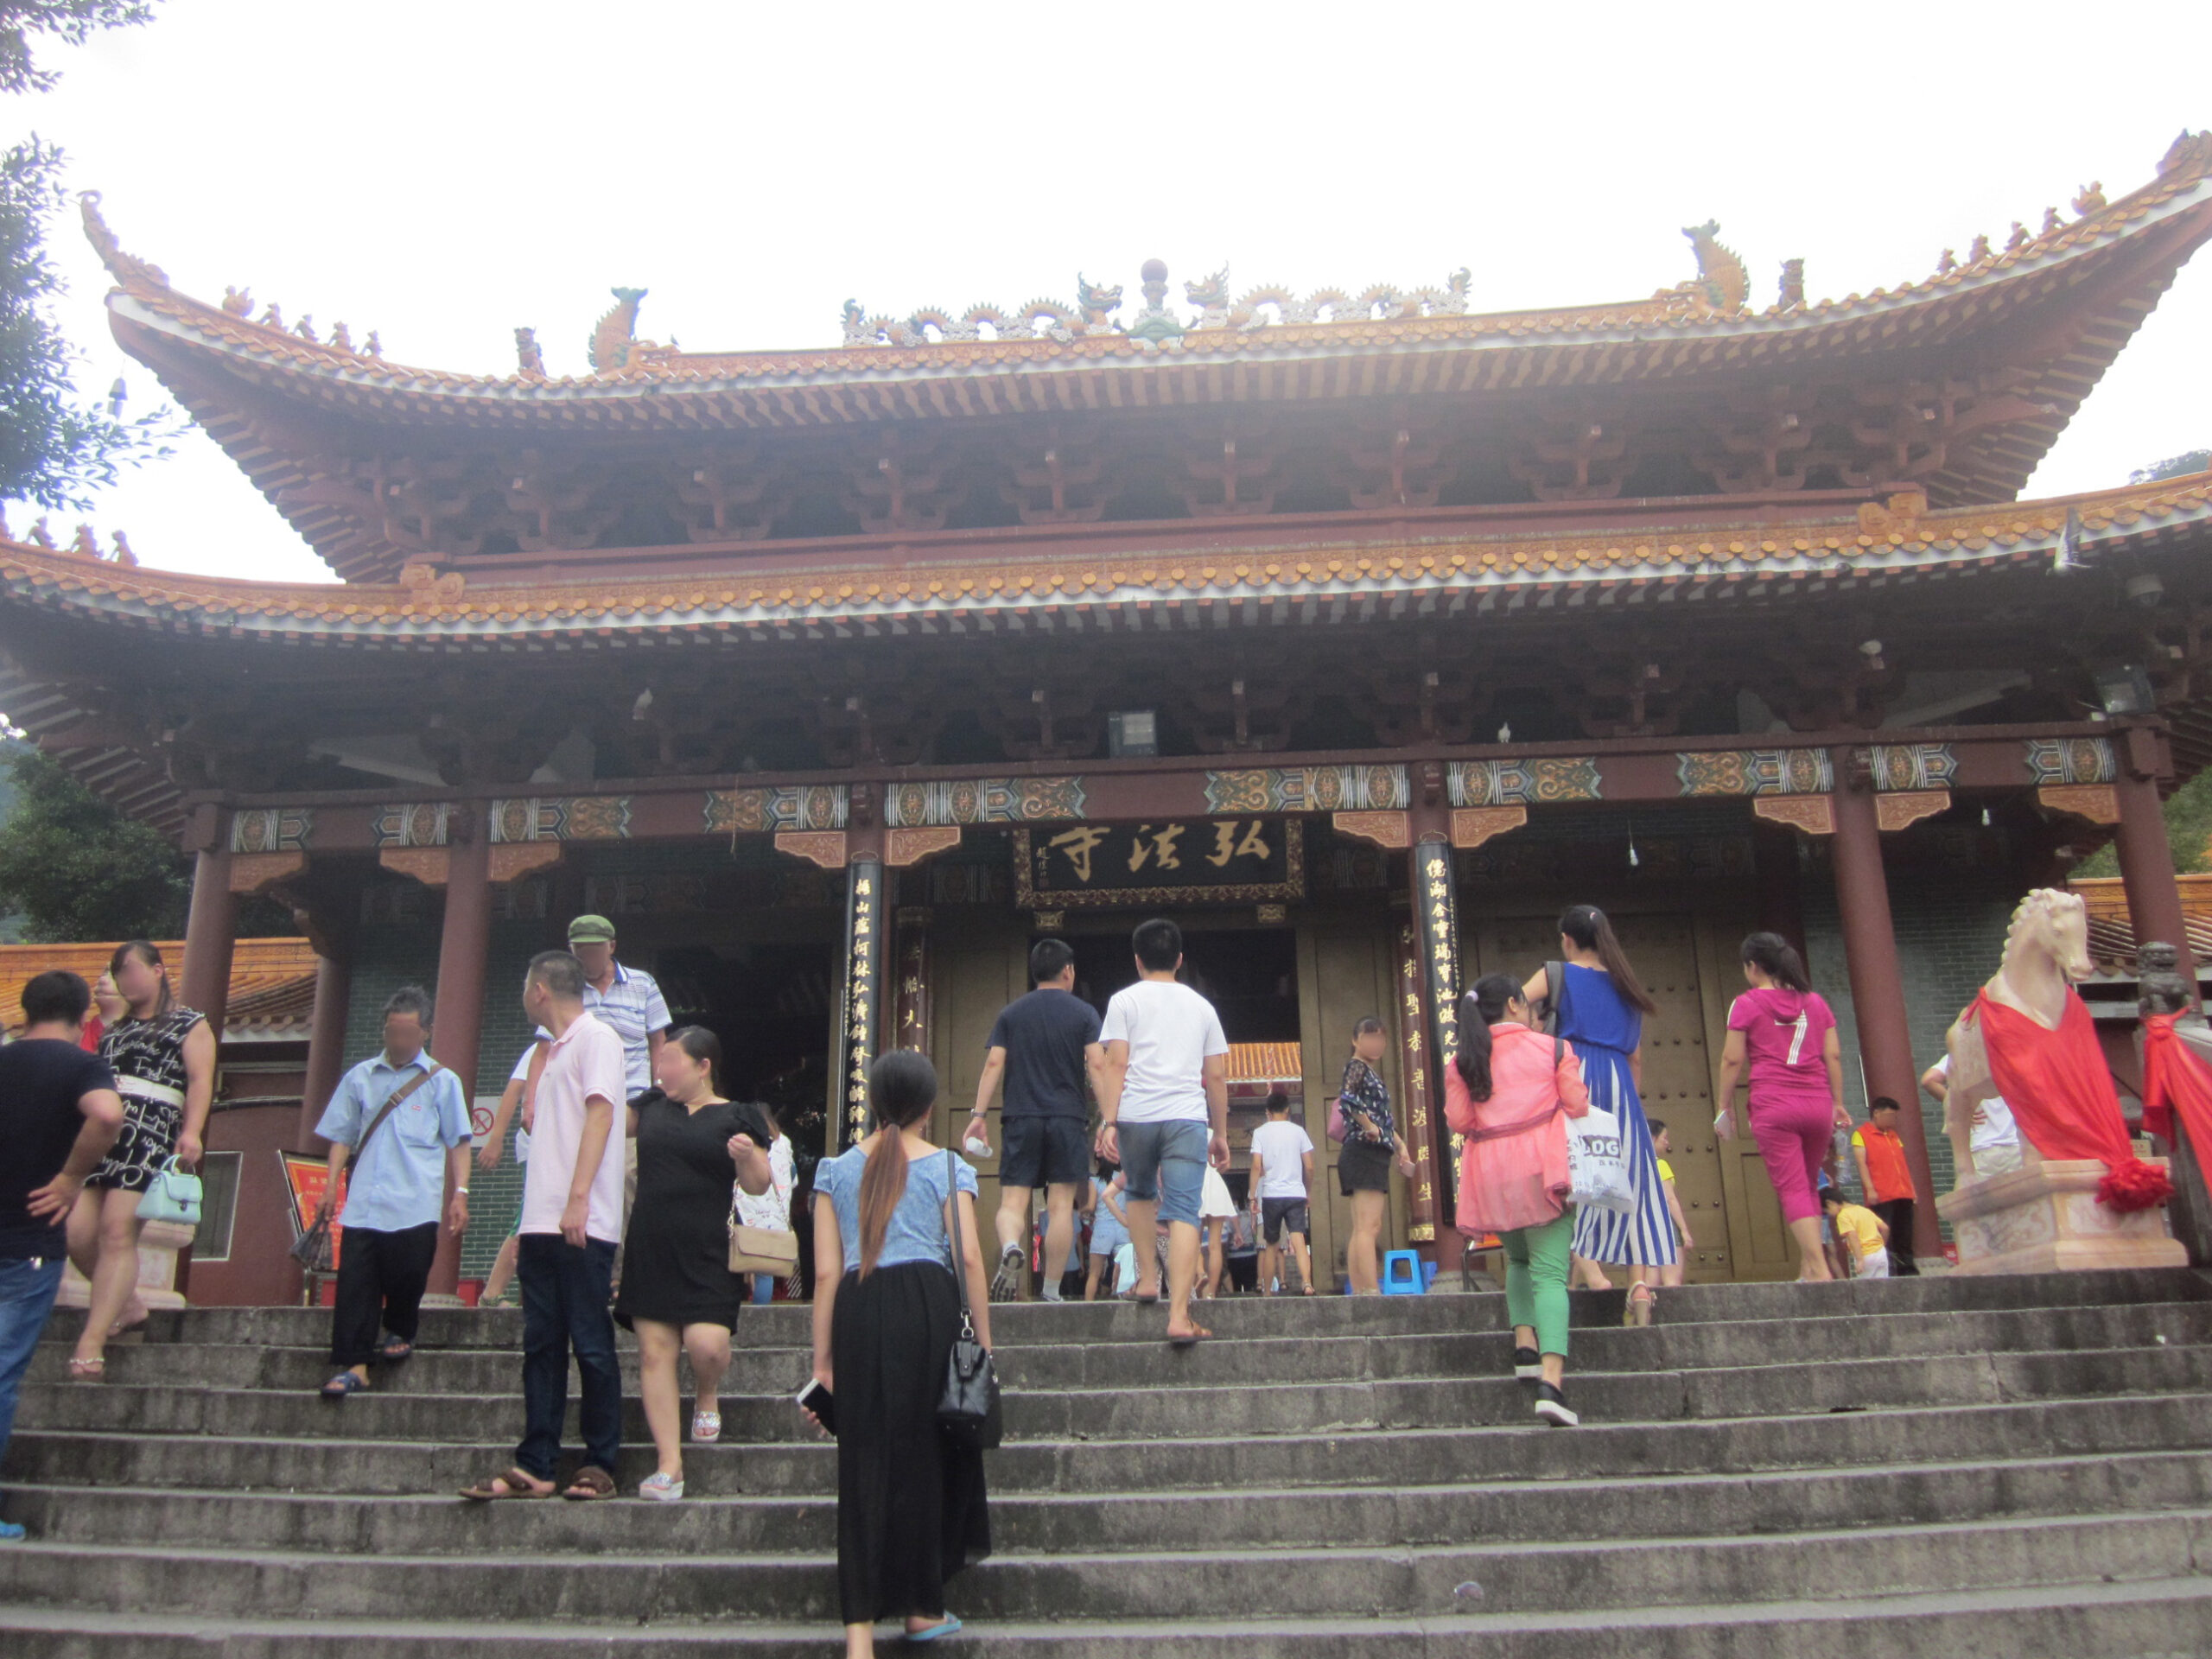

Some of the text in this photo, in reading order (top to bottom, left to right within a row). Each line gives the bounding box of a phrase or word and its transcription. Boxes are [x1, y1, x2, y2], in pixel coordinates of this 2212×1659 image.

[1048, 820, 1271, 882] 弘法寺
[1774, 1008, 1808, 1065] 7
